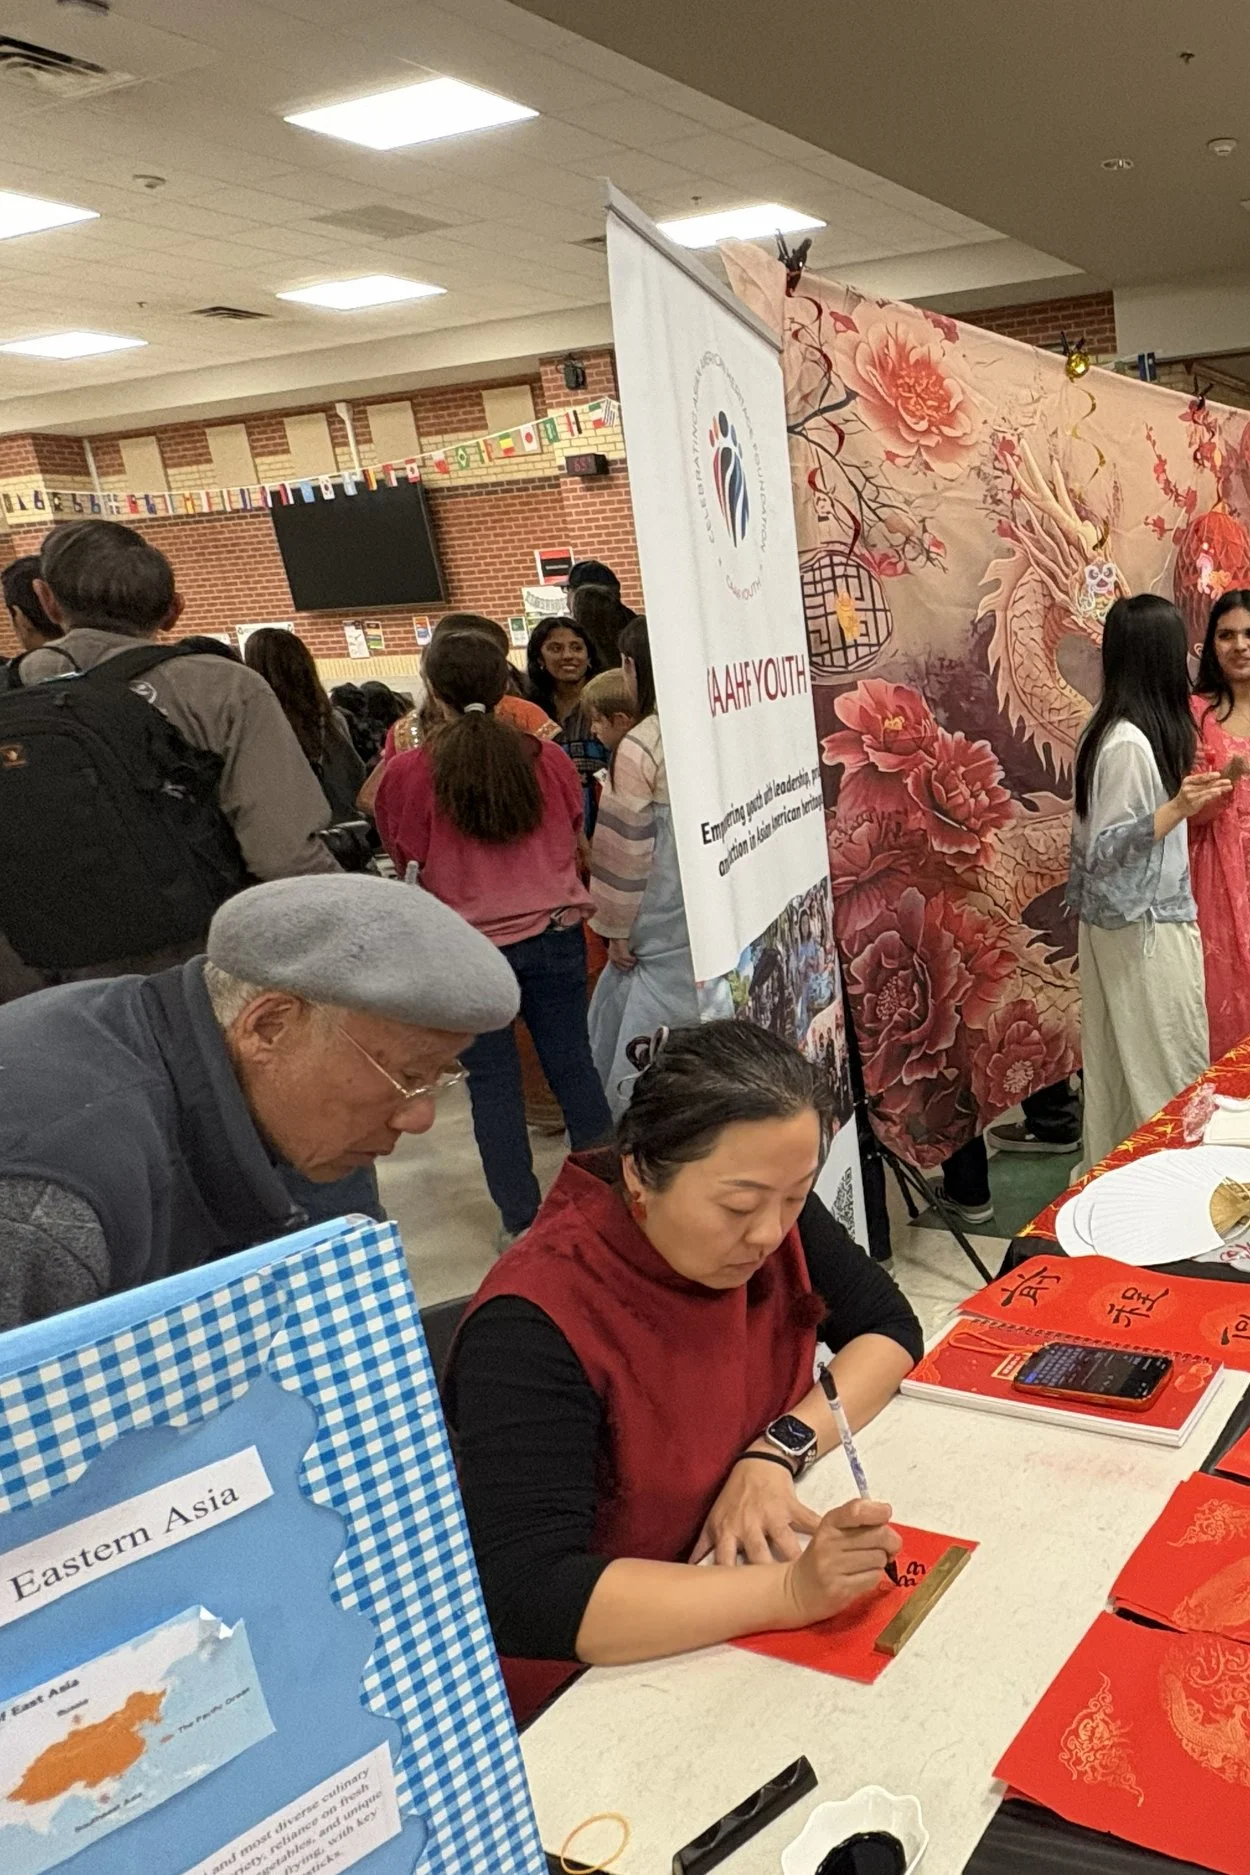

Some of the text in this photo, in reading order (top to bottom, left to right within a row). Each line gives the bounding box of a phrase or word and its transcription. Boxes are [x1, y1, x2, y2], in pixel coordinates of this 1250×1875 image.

[751, 444, 768, 553] FOUNDATION
[701, 802, 746, 845] Empering
[772, 767, 811, 798] leadership,
[748, 829, 757, 851] in
[800, 793, 824, 816] heritag
[8, 1487, 240, 1603] Eastern Asia
[11, 1695, 44, 1716] East
[48, 1678, 80, 1698] Asia
[57, 1698, 89, 1718] Russia
[177, 1721, 193, 1734] The
[123, 1792, 143, 1806] Asia
[212, 1768, 370, 1875] and most diverse culinary
[234, 1783, 370, 1875] riety, reliance on fresh
[256, 1790, 382, 1875] getables, and unique
[284, 1808, 378, 1875] frying, with key
[303, 1850, 343, 1875] sticks.
